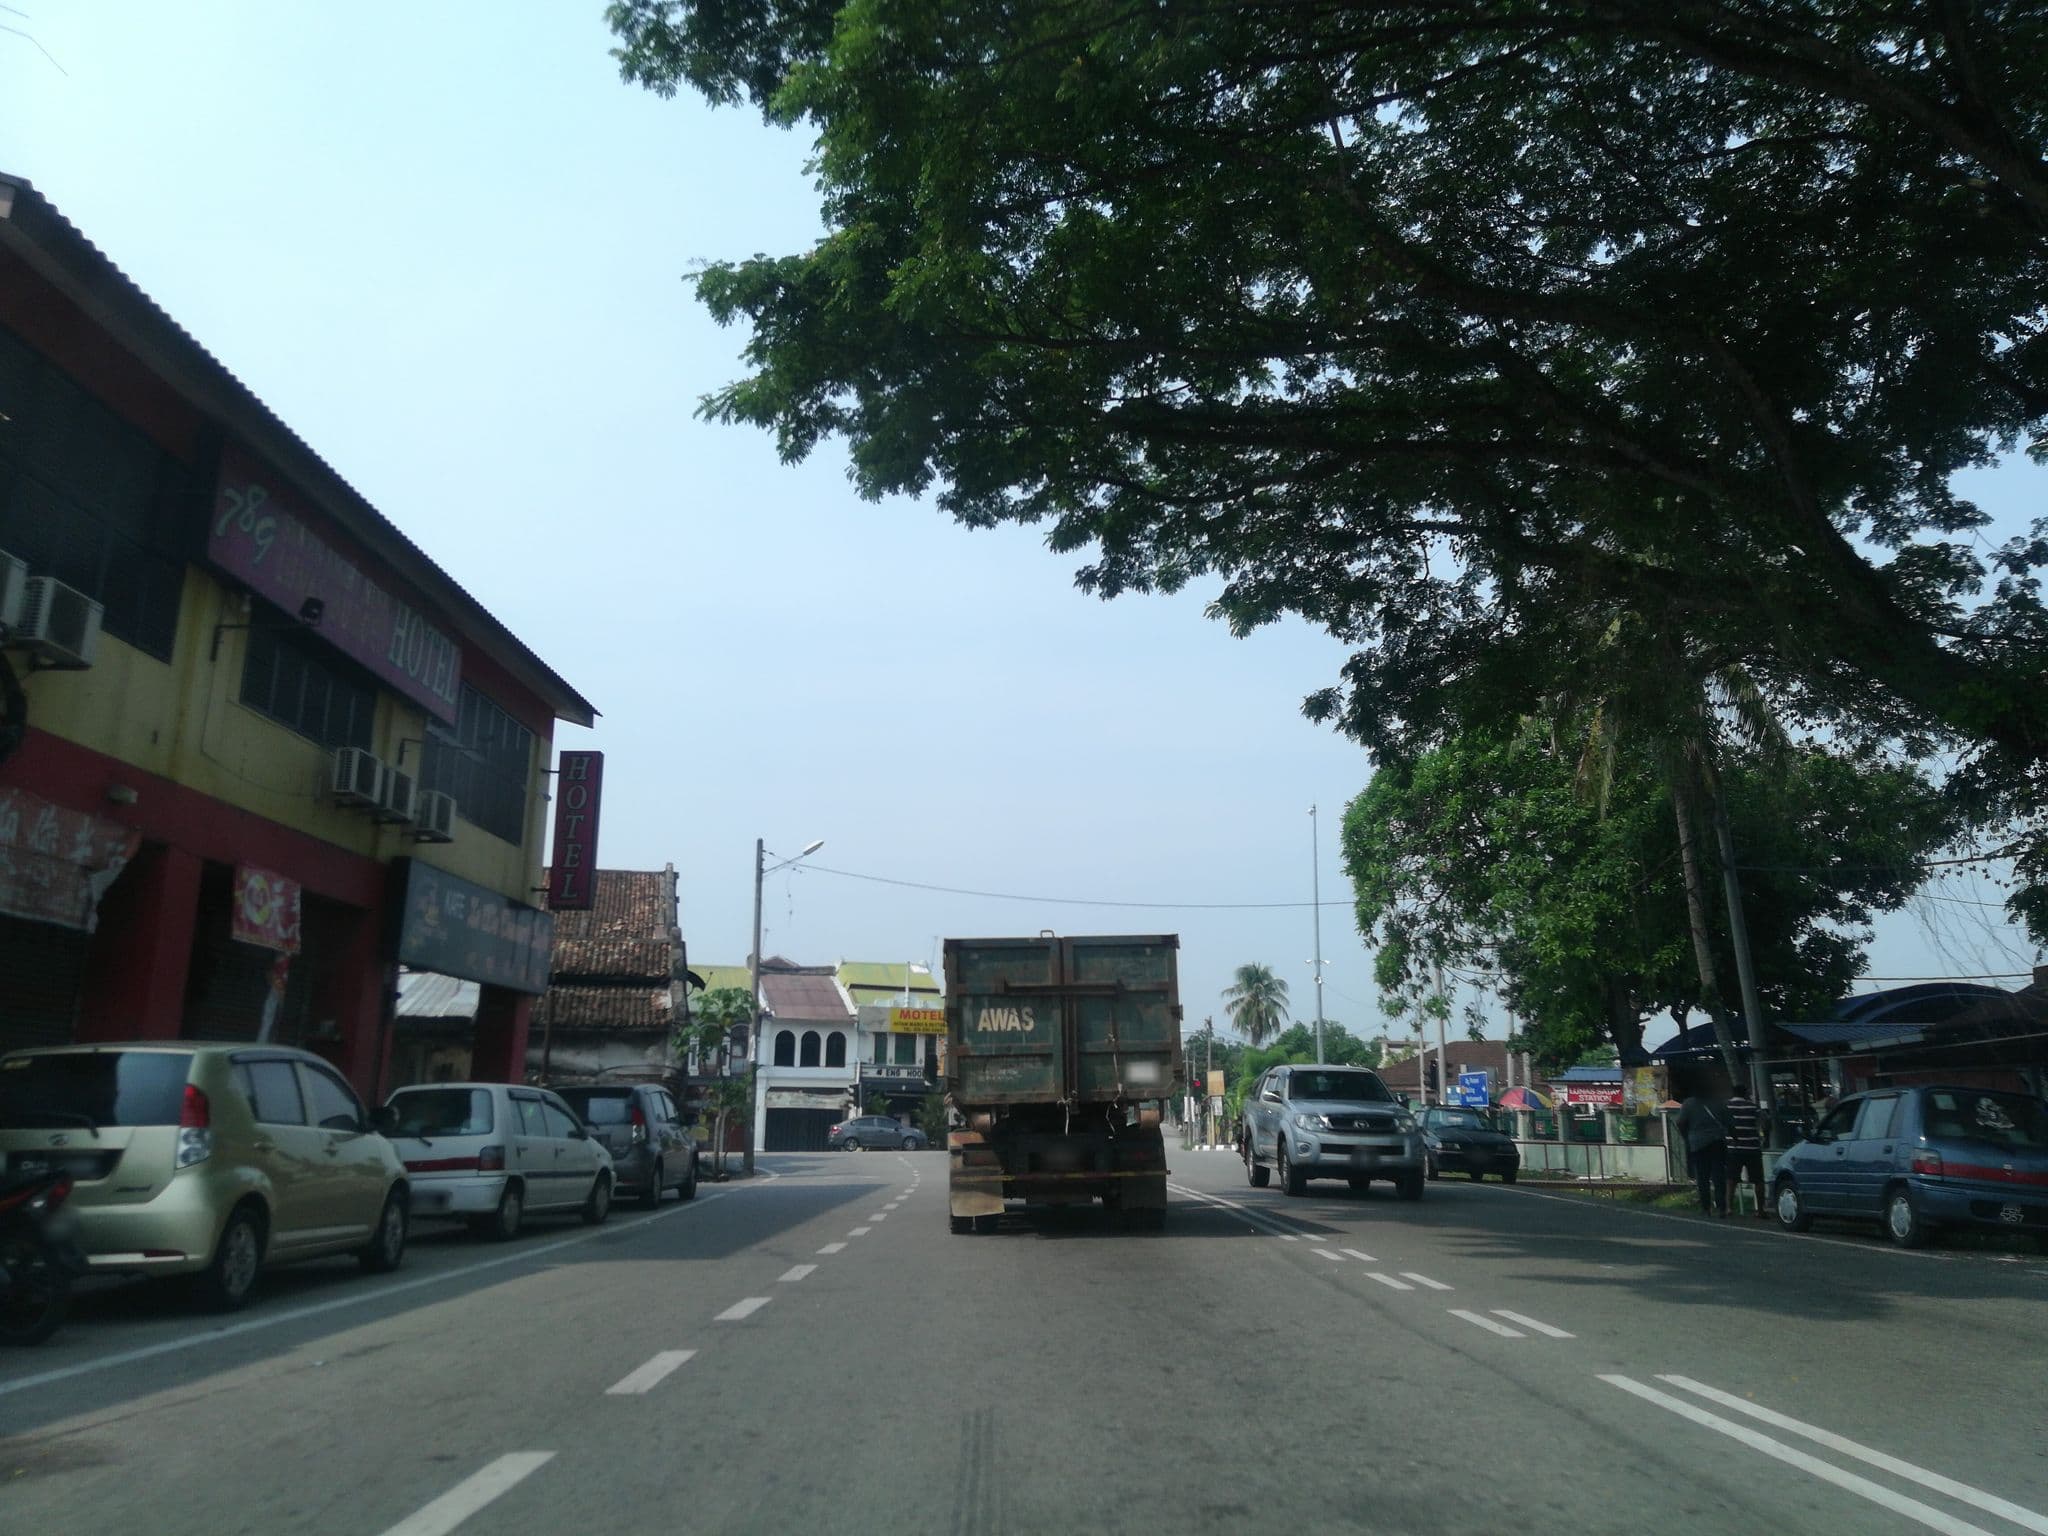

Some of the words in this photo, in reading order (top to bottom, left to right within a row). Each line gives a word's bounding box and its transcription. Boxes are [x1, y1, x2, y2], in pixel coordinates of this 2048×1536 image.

[216, 484, 276, 565] 789
[389, 600, 457, 704] HOTEL
[560, 756, 592, 898] HOTEL
[900, 1009, 944, 1020] MOTEL
[977, 1006, 1034, 1032] AWAS
